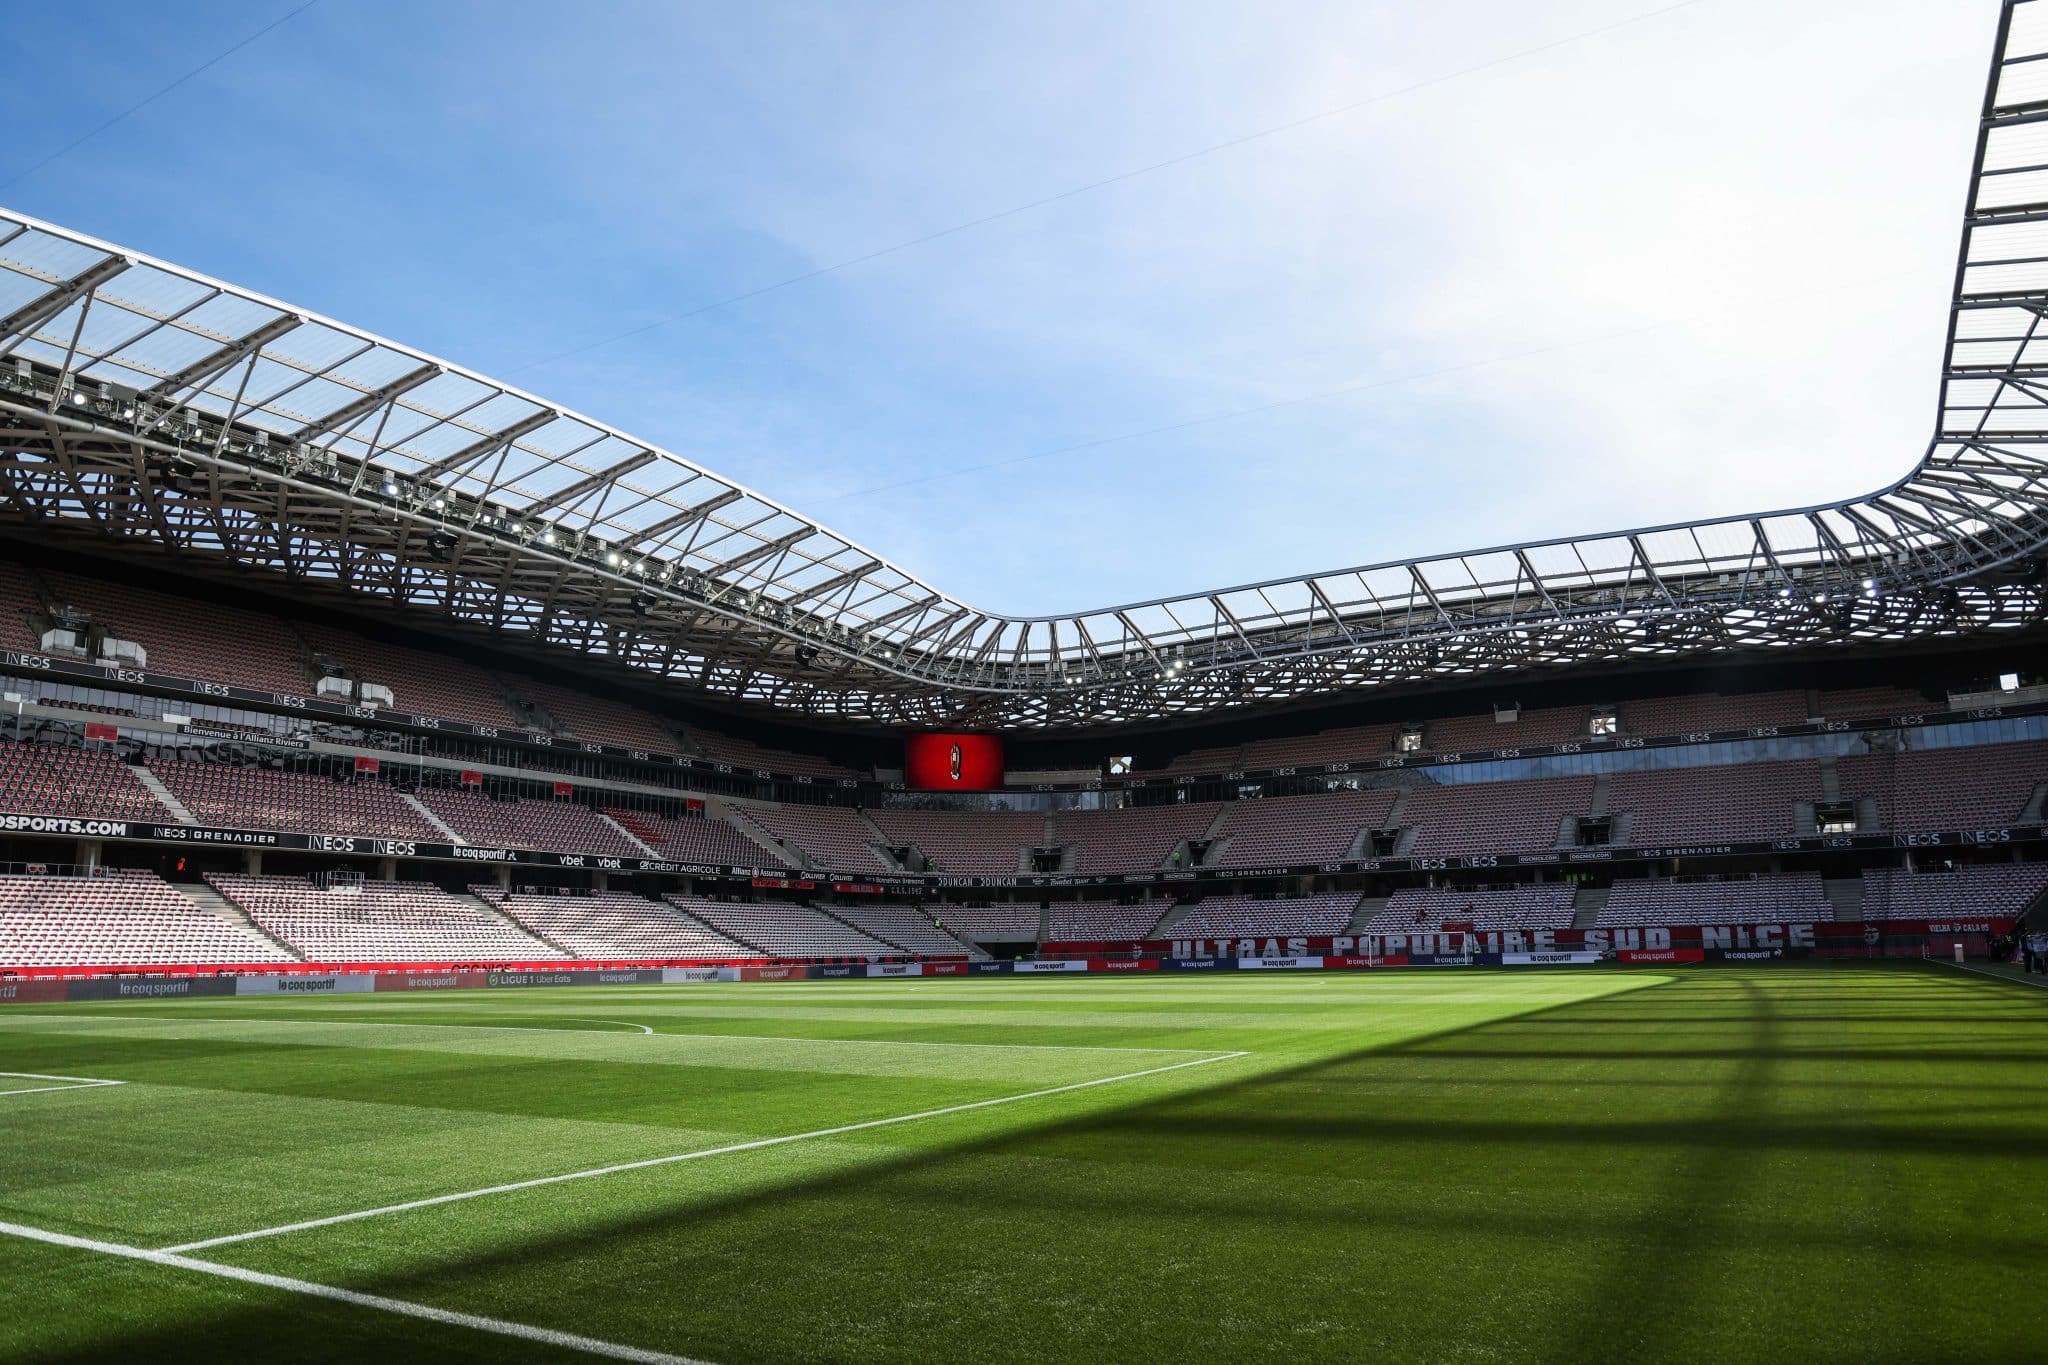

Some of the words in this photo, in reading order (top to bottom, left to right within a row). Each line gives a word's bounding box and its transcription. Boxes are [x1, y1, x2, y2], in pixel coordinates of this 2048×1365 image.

[6, 652, 50, 669] INEOS
[105, 667, 145, 683] INEOS
[193, 681, 229, 696] INEOS
[273, 694, 306, 708] INEOS
[345, 705, 376, 719] INEOS
[1967, 708, 2002, 719] INEOS
[411, 717, 439, 729] INEOS
[1891, 714, 1924, 726] INEOS
[472, 725, 498, 737] INEOS
[1748, 726, 1778, 737] INEOS
[1818, 721, 1850, 732] INEOS
[183, 724, 232, 739] Bienvenue
[240, 733, 273, 744] l'Allianz
[275, 737, 304, 748] Riviera
[528, 734, 552, 746] INEOS
[1680, 732, 1710, 742] INEOS
[580, 743, 602, 754] INEOS
[1553, 743, 1581, 753] INEOS
[1615, 738, 1644, 749] INEOS
[628, 750, 649, 761] INEOS
[1435, 754, 1461, 763] INEOS
[1493, 749, 1519, 758] INEOS
[1325, 763, 1349, 772] INEOS
[1380, 759, 1404, 768] INEOS
[1222, 772, 1245, 781] INEOS
[1272, 768, 1296, 776] INEOS
[836, 779, 857, 788] INEOS
[1080, 781, 1102, 791] INEOS
[1173, 776, 1195, 785] INEOS
[883, 782, 905, 792] INEOS
[1030, 783, 1054, 792] INEOS
[154, 827, 186, 839] INEOS
[193, 830, 276, 844] GRENADIER
[1893, 834, 1940, 847] INEOS
[1960, 829, 2010, 844] INEOS
[308, 835, 354, 852] INEOS
[373, 840, 416, 856] INEOS
[1772, 840, 1800, 850] INEOS
[1823, 838, 1852, 848] INEOS
[453, 845, 461, 857] le
[462, 849, 478, 860] coq
[478, 848, 506, 861] sportif
[1665, 846, 1731, 855] GRENADIER
[559, 855, 584, 867] vbet
[597, 858, 621, 869] vbet
[1357, 862, 1380, 871] INEOS
[1410, 858, 1446, 870] INEOS
[1461, 856, 1498, 868] INEOS
[650, 861, 679, 872] CRÉDIT
[680, 865, 721, 875] AGRICOLE
[731, 867, 751, 876] Allianz
[1237, 868, 1288, 877] GRENADIER
[1318, 863, 1341, 872] INEOS
[943, 877, 973, 887] DUNCAN
[985, 877, 1017, 887] DUNCAN
[1172, 937, 1308, 959] ULTRAS
[1332, 932, 1555, 955] POPULAIRE
[1584, 927, 1671, 950] SUD
[1702, 924, 1816, 949] NICE
[1537, 955, 1549, 963] coq
[1549, 954, 1571, 963] sportif
[1631, 952, 1638, 960] le
[1638, 953, 1651, 961] coq
[1652, 952, 1675, 961] sportif
[1732, 952, 1746, 960] coq
[1746, 951, 1770, 960] sportif
[1278, 959, 1297, 967] sportif
[278, 979, 287, 991] le
[288, 980, 305, 992] coq
[306, 978, 335, 992] sportif
[408, 977, 416, 987] le
[416, 978, 431, 988] coq
[432, 976, 457, 988] sportif
[500, 975, 528, 985] LIGUE
[529, 975, 534, 983] 1
[536, 974, 553, 983] Uber
[554, 974, 571, 983] Eats
[120, 982, 131, 994] le
[131, 984, 153, 996] coq
[154, 981, 190, 996] sportif
